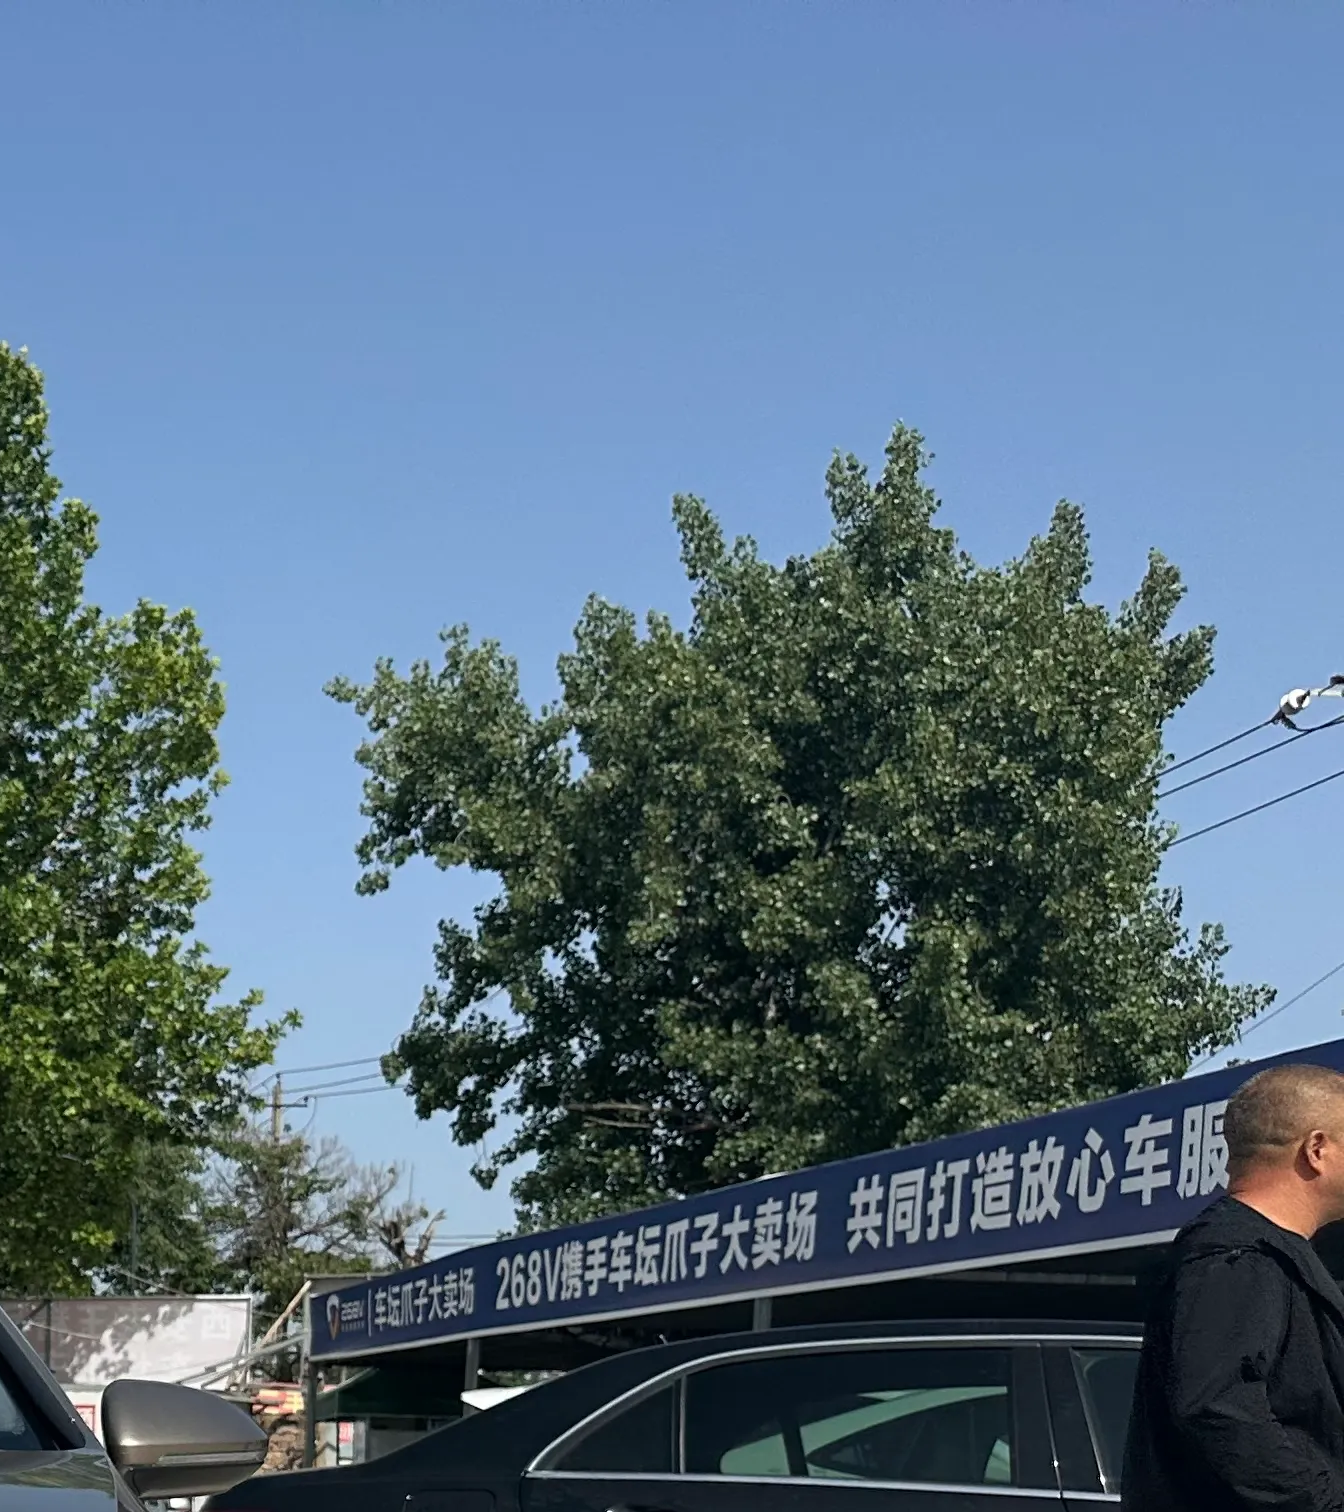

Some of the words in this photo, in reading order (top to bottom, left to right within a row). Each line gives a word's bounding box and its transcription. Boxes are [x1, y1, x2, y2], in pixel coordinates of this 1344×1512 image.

[374, 1267, 475, 1331] 车坛爪子大卖场
